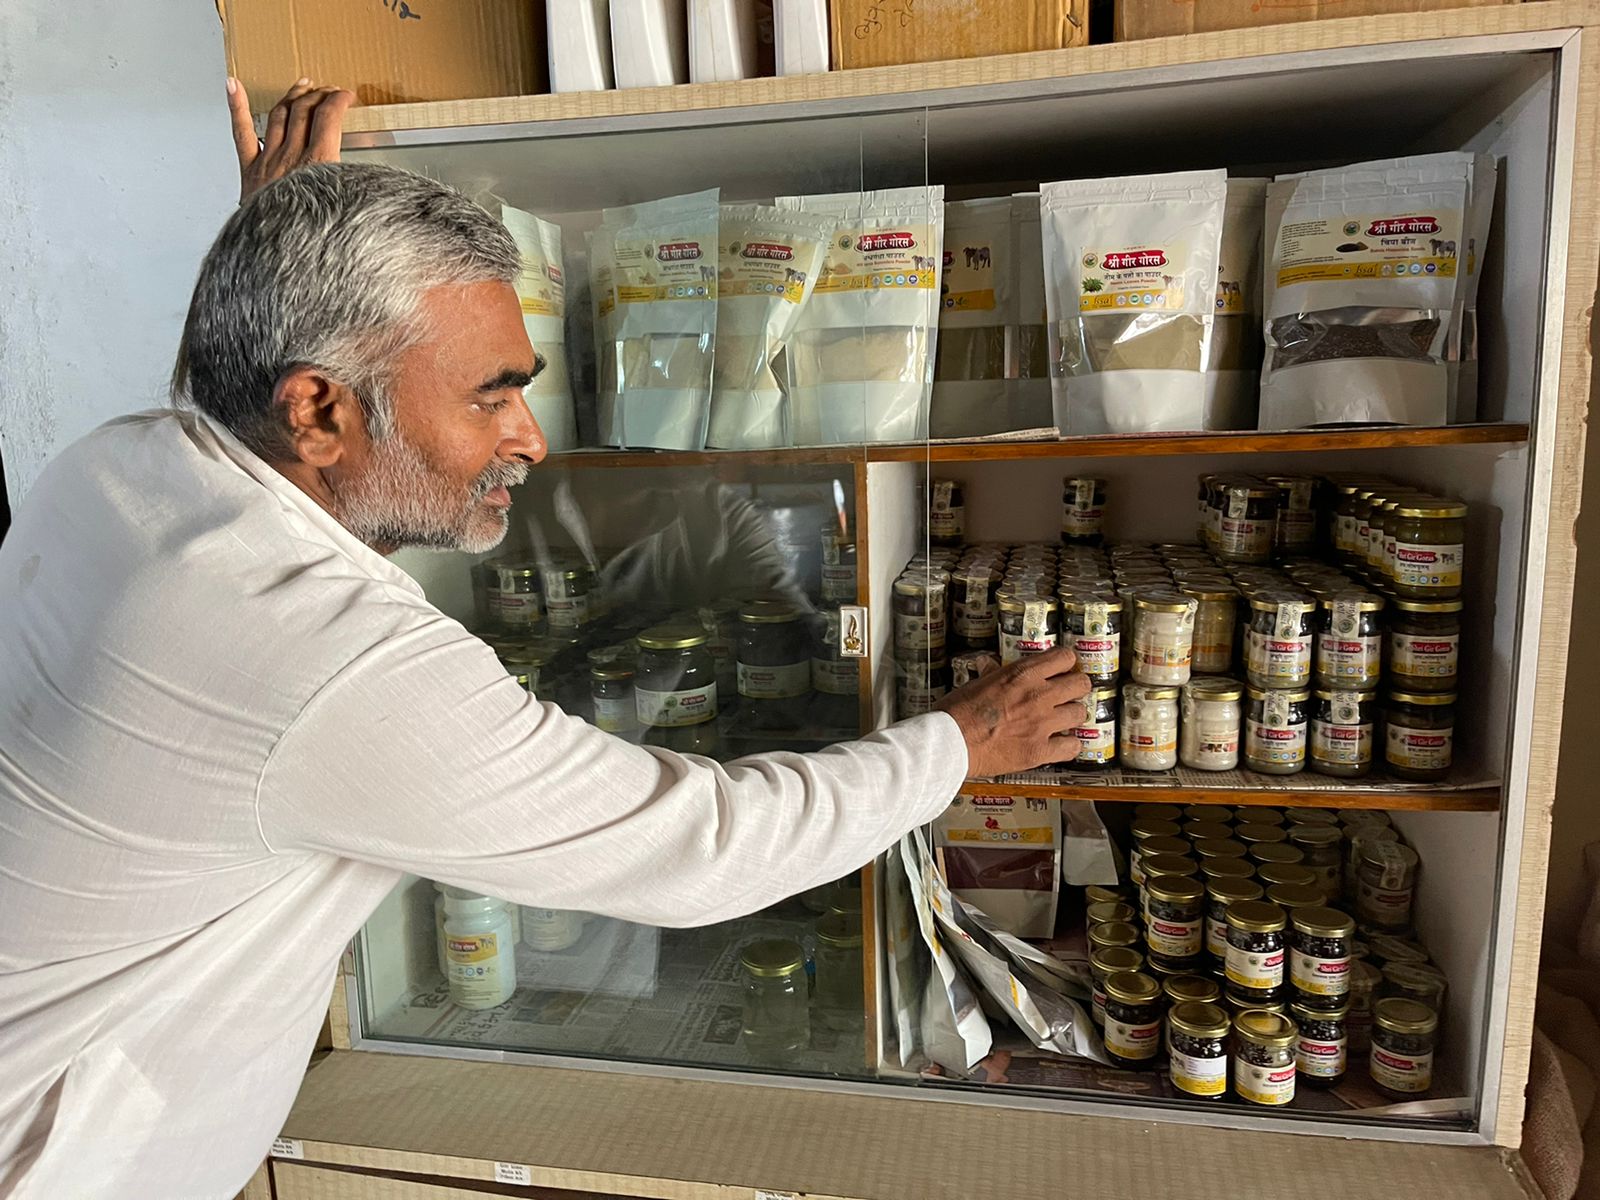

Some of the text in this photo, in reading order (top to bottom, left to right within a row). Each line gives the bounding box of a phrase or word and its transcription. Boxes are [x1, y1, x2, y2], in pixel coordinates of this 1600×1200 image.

[1374, 219, 1432, 234] श्री गीर गोरस
[875, 236, 887, 248] गीर
[889, 234, 909, 247] गोरस
[1108, 253, 1161, 268] श्री गीर गोरस
